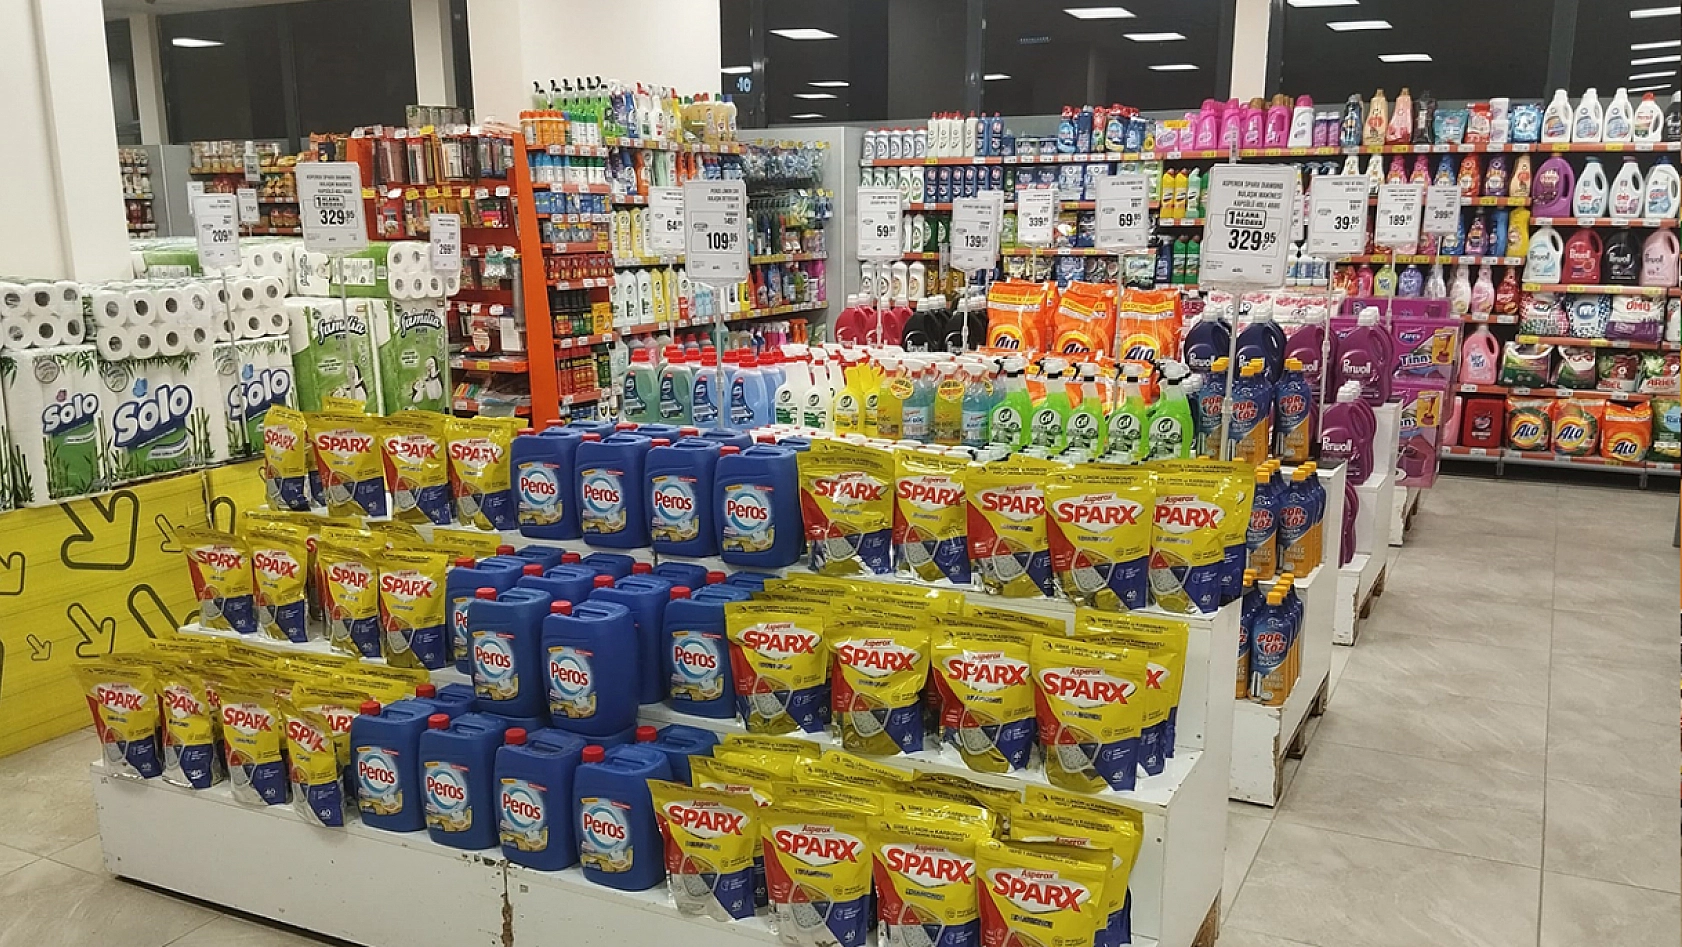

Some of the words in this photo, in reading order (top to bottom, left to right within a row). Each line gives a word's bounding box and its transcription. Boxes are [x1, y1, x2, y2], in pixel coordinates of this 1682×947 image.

[1229, 211, 1235, 224] 1
[318, 316, 366, 345] famlia
[401, 308, 442, 338] familia
[1342, 360, 1371, 375] Perwoll
[229, 368, 290, 418] Solo
[44, 394, 98, 432] Solo
[115, 386, 192, 446] Solo
[318, 435, 373, 454] SPARX
[1322, 437, 1351, 452] Perwoll
[520, 477, 556, 495] Peros
[584, 484, 619, 502] Peros
[815, 480, 882, 500] SPARX
[899, 481, 966, 506] SPARX
[654, 491, 692, 510] Peros
[727, 500, 768, 520] Peros
[1083, 494, 1113, 503] Asperox
[1058, 503, 1137, 525] SPARX
[1154, 507, 1218, 529] PARX
[197, 550, 241, 569] SPARX
[254, 554, 298, 578] SPARX
[331, 567, 369, 588] SPAR
[382, 577, 431, 598] SPARX
[744, 630, 816, 654] SPARX
[475, 646, 510, 669] Peros
[674, 646, 716, 669] Peros
[839, 645, 916, 672] SPARX
[551, 662, 588, 685] Peros
[948, 660, 1027, 685] SPARX
[97, 688, 142, 710] SPARX
[1043, 673, 1128, 704] SPARX
[224, 708, 272, 732] SPARX
[359, 762, 395, 784] Peros
[427, 776, 464, 800] Peros
[503, 793, 541, 820] Peros
[584, 812, 625, 840] Peros
[670, 806, 743, 836] SPARX
[775, 831, 858, 862] SPARX
[887, 848, 973, 884] SPARX
[1021, 870, 1054, 879] Asperox
[993, 872, 1084, 912] SPARX
